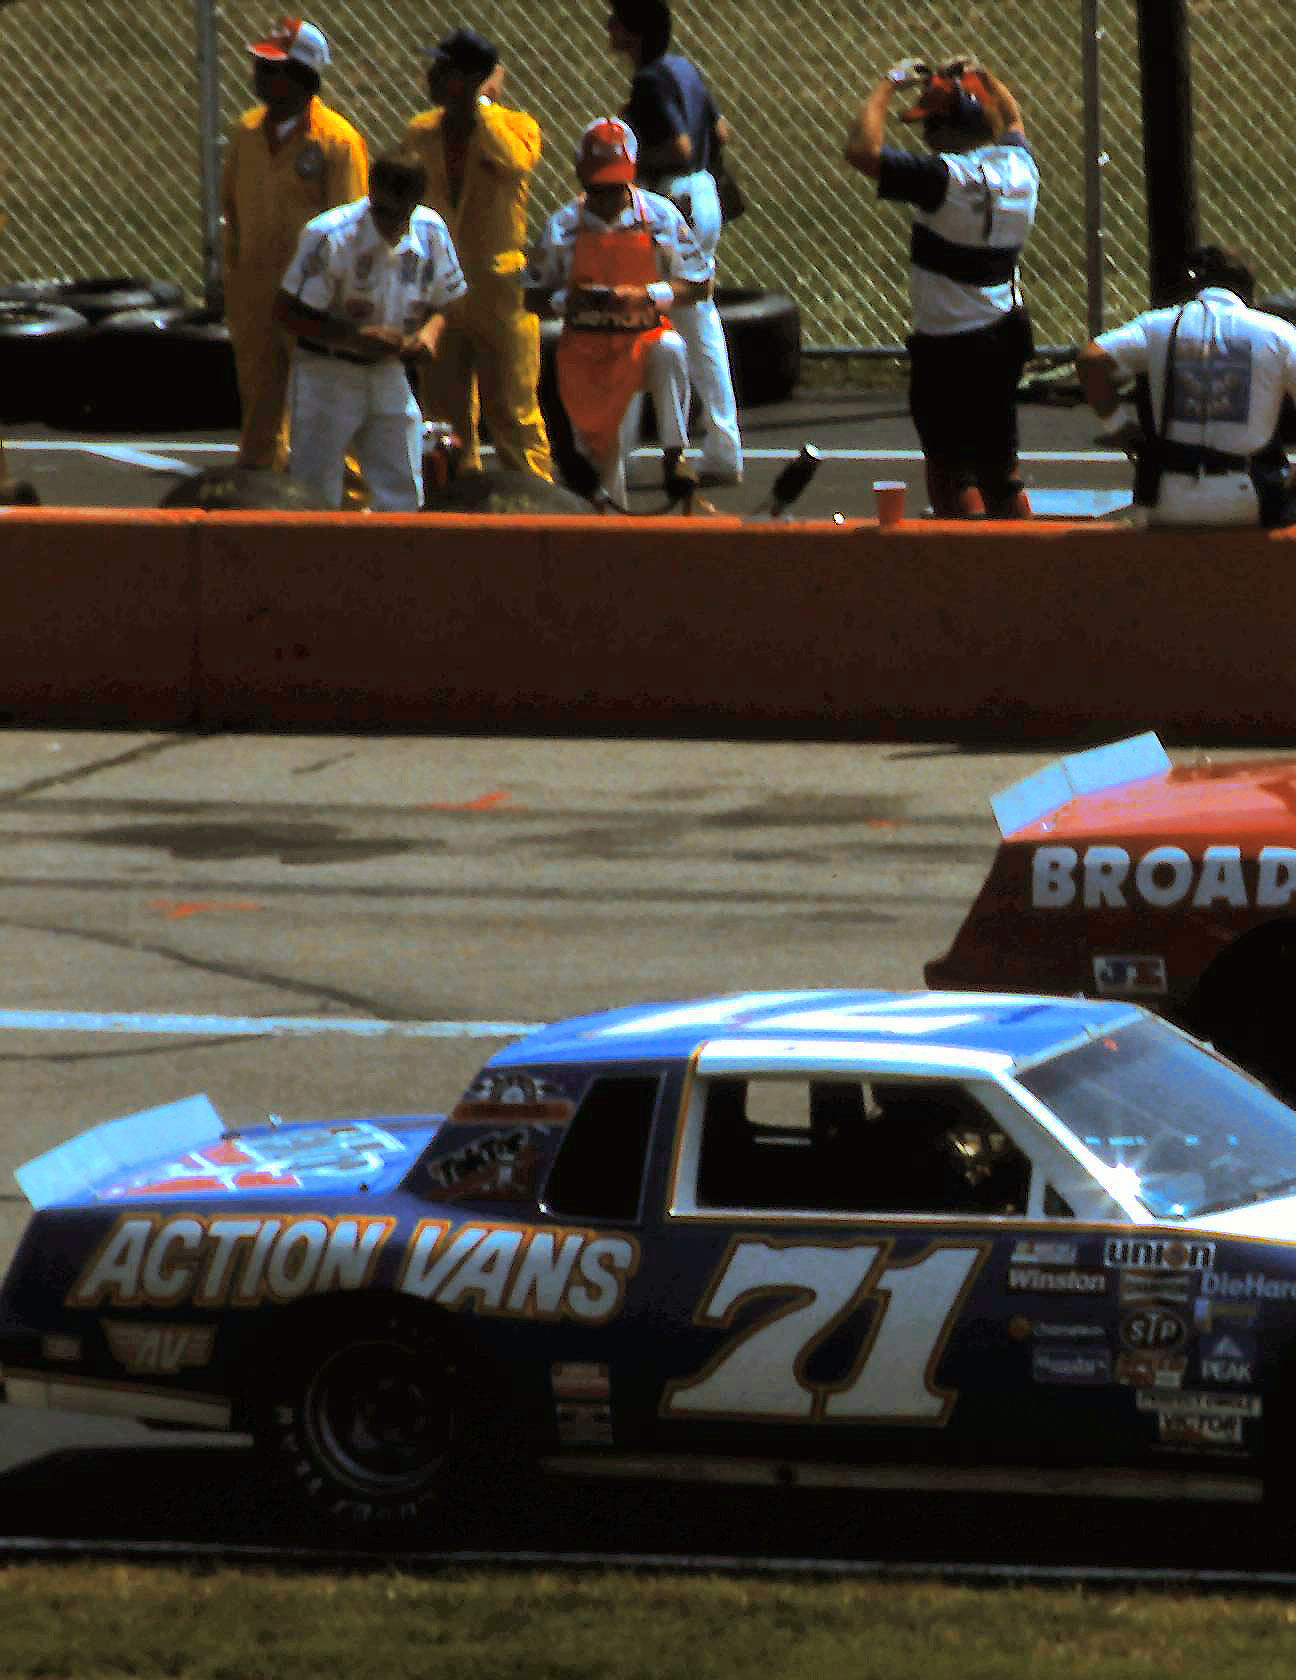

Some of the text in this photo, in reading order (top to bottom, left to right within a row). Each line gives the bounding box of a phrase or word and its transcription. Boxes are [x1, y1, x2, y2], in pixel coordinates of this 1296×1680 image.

[66, 1212, 640, 1326] ACTION VANS
[657, 1232, 993, 1428] 71
[1130, 1310, 1182, 1346] STP
